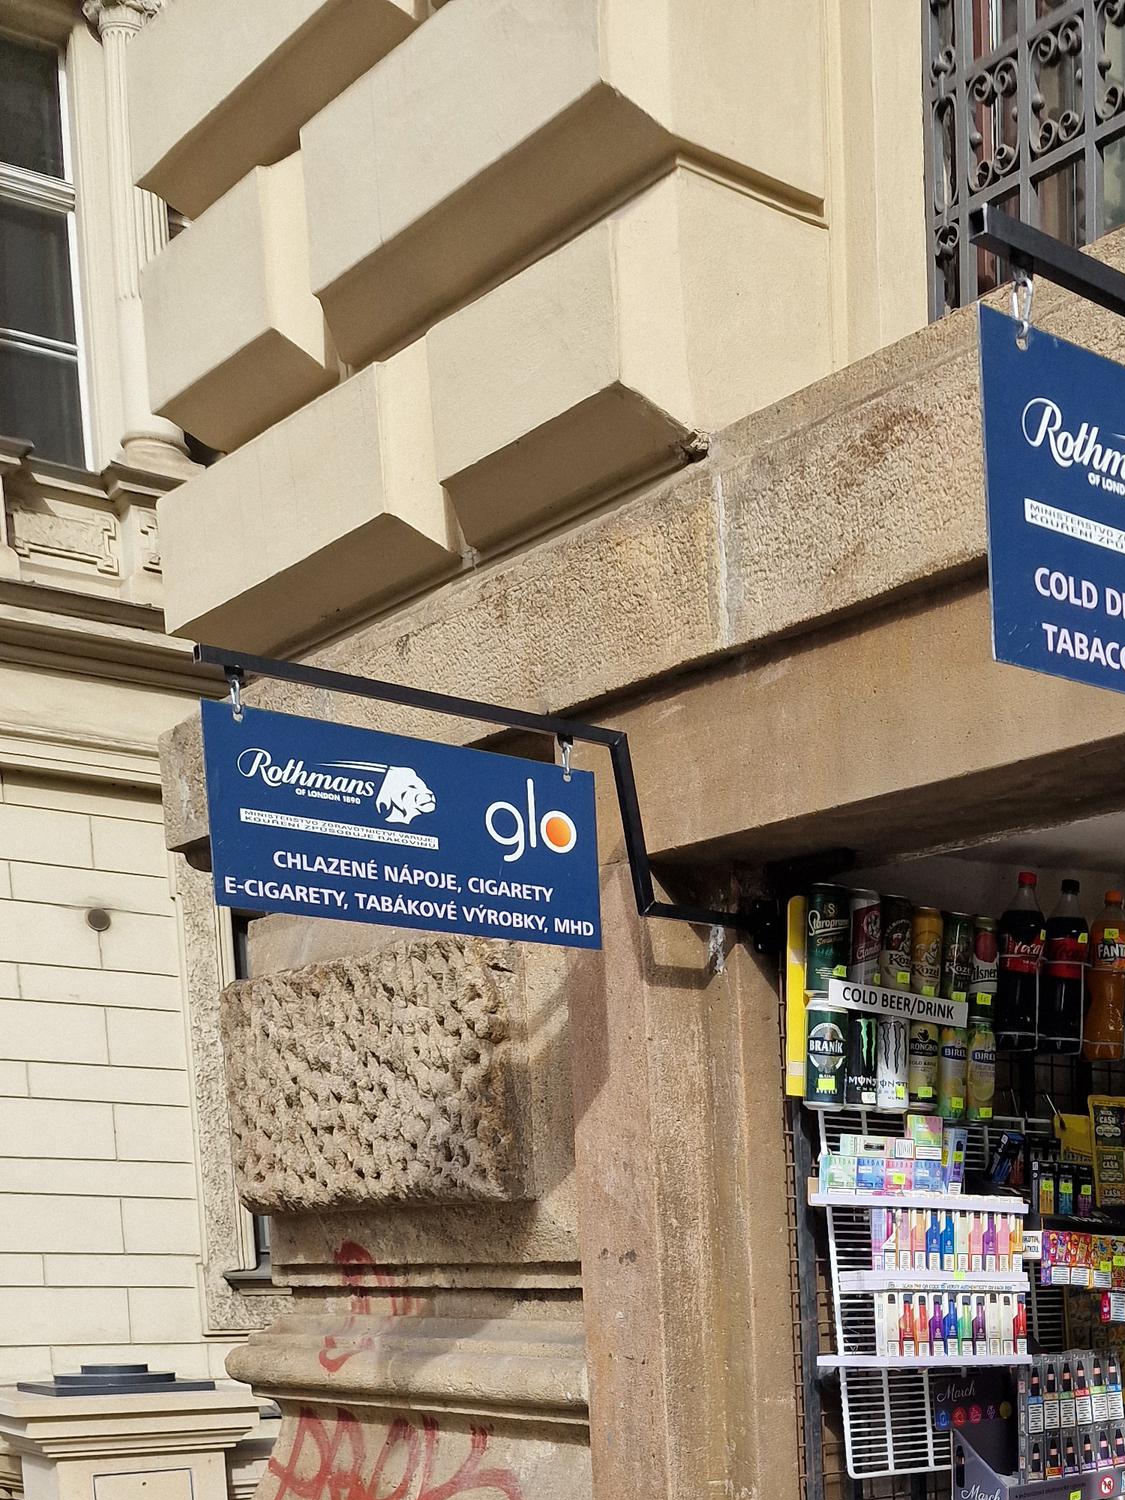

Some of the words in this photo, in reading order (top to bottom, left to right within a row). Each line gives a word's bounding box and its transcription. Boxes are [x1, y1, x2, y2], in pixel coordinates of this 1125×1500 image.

[1088, 472, 1101, 487] OF
[1030, 503, 1114, 536] MINISTERSTVO
[1034, 566, 1098, 610] COLD
[237, 747, 375, 797] Rothmans
[295, 787, 305, 796] OF
[307, 789, 340, 802] LONDON
[342, 795, 361, 805] 1890
[485, 778, 578, 862] glo
[273, 851, 379, 881] CHLAZENÉ
[384, 864, 462, 894] NÁPOJE,
[468, 877, 554, 903] CIGARETY
[224, 876, 349, 910] E-CIGARETY,
[354, 890, 457, 921] TABÁKOVÉ
[461, 903, 549, 934] VÝROBKY,
[554, 918, 594, 937] MHD
[842, 986, 877, 1006] COLD
[881, 995, 954, 1020] BEER/DRINK
[809, 1039, 843, 1053] BRANÍK
[937, 1381, 976, 1402] March
